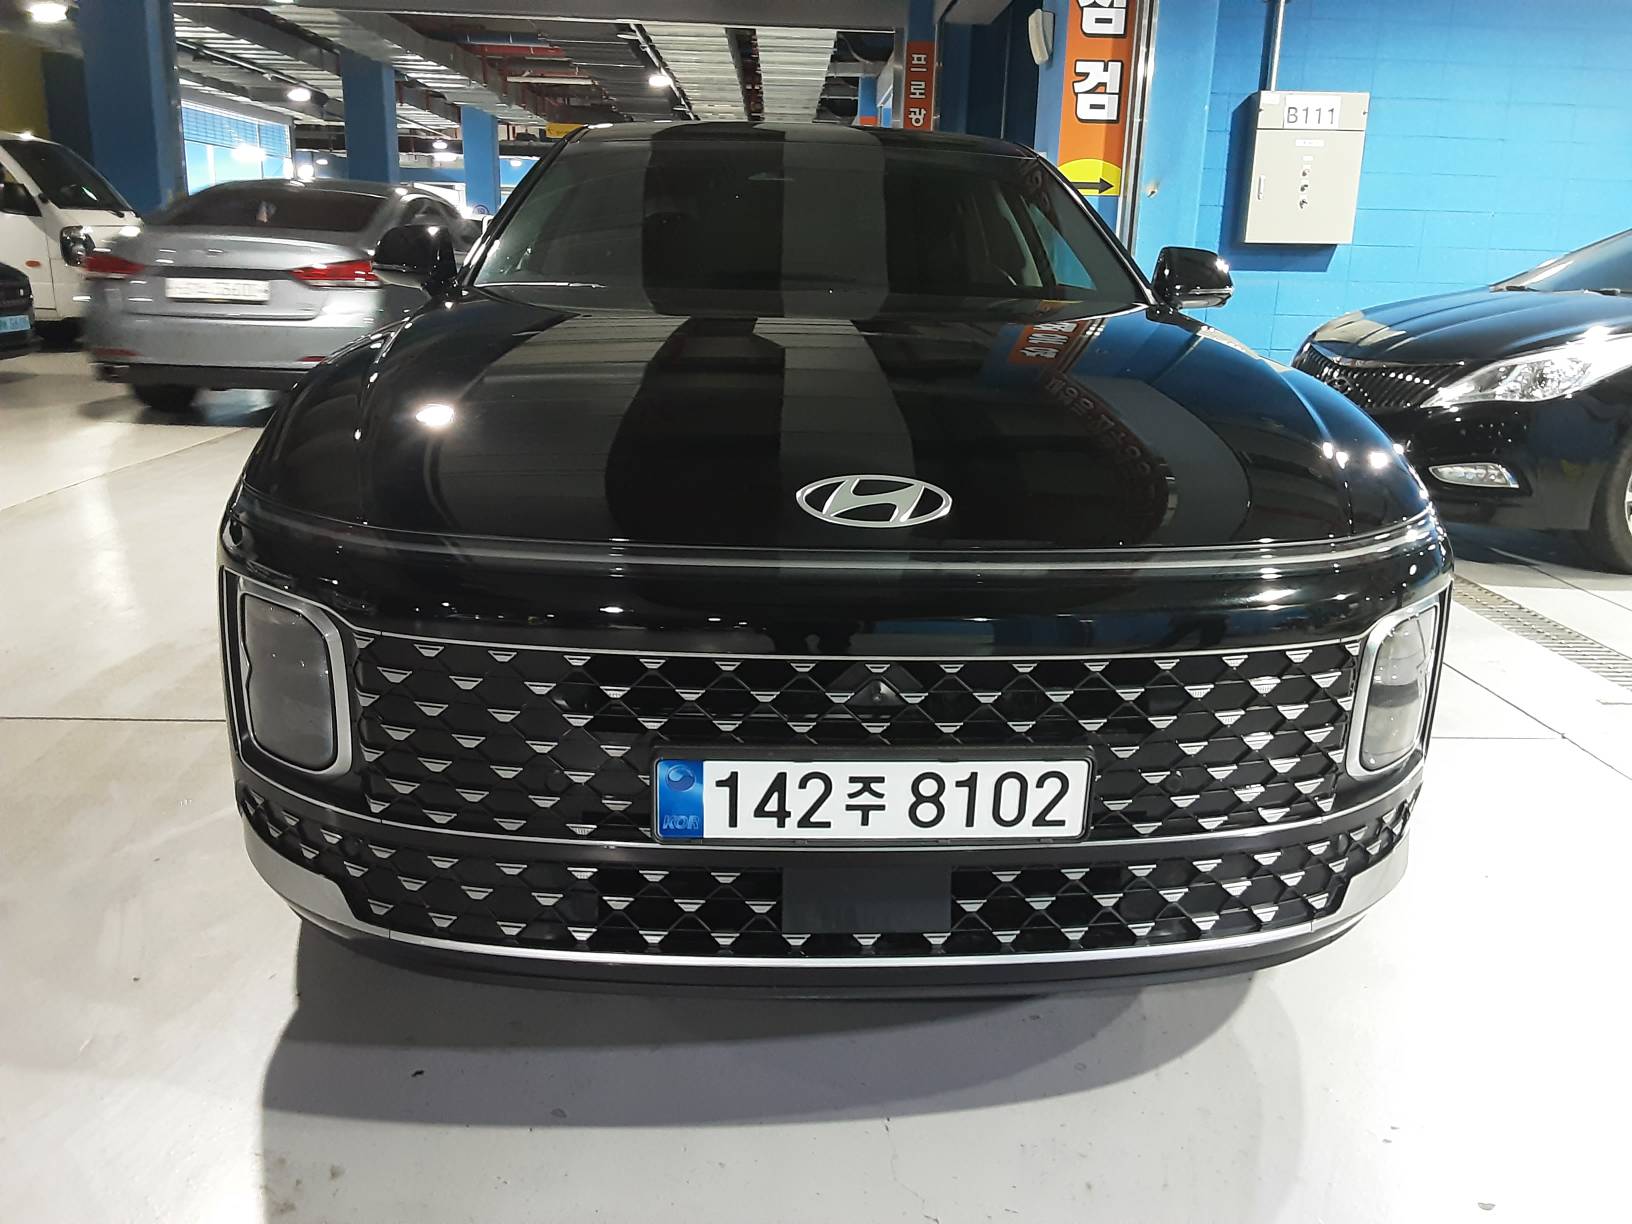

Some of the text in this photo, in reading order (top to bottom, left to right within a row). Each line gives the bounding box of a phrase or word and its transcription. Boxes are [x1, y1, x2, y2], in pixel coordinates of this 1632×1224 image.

[1286, 106, 1335, 125] B111
[715, 771, 1070, 829] 142주 8102
[662, 814, 700, 830] KOR
